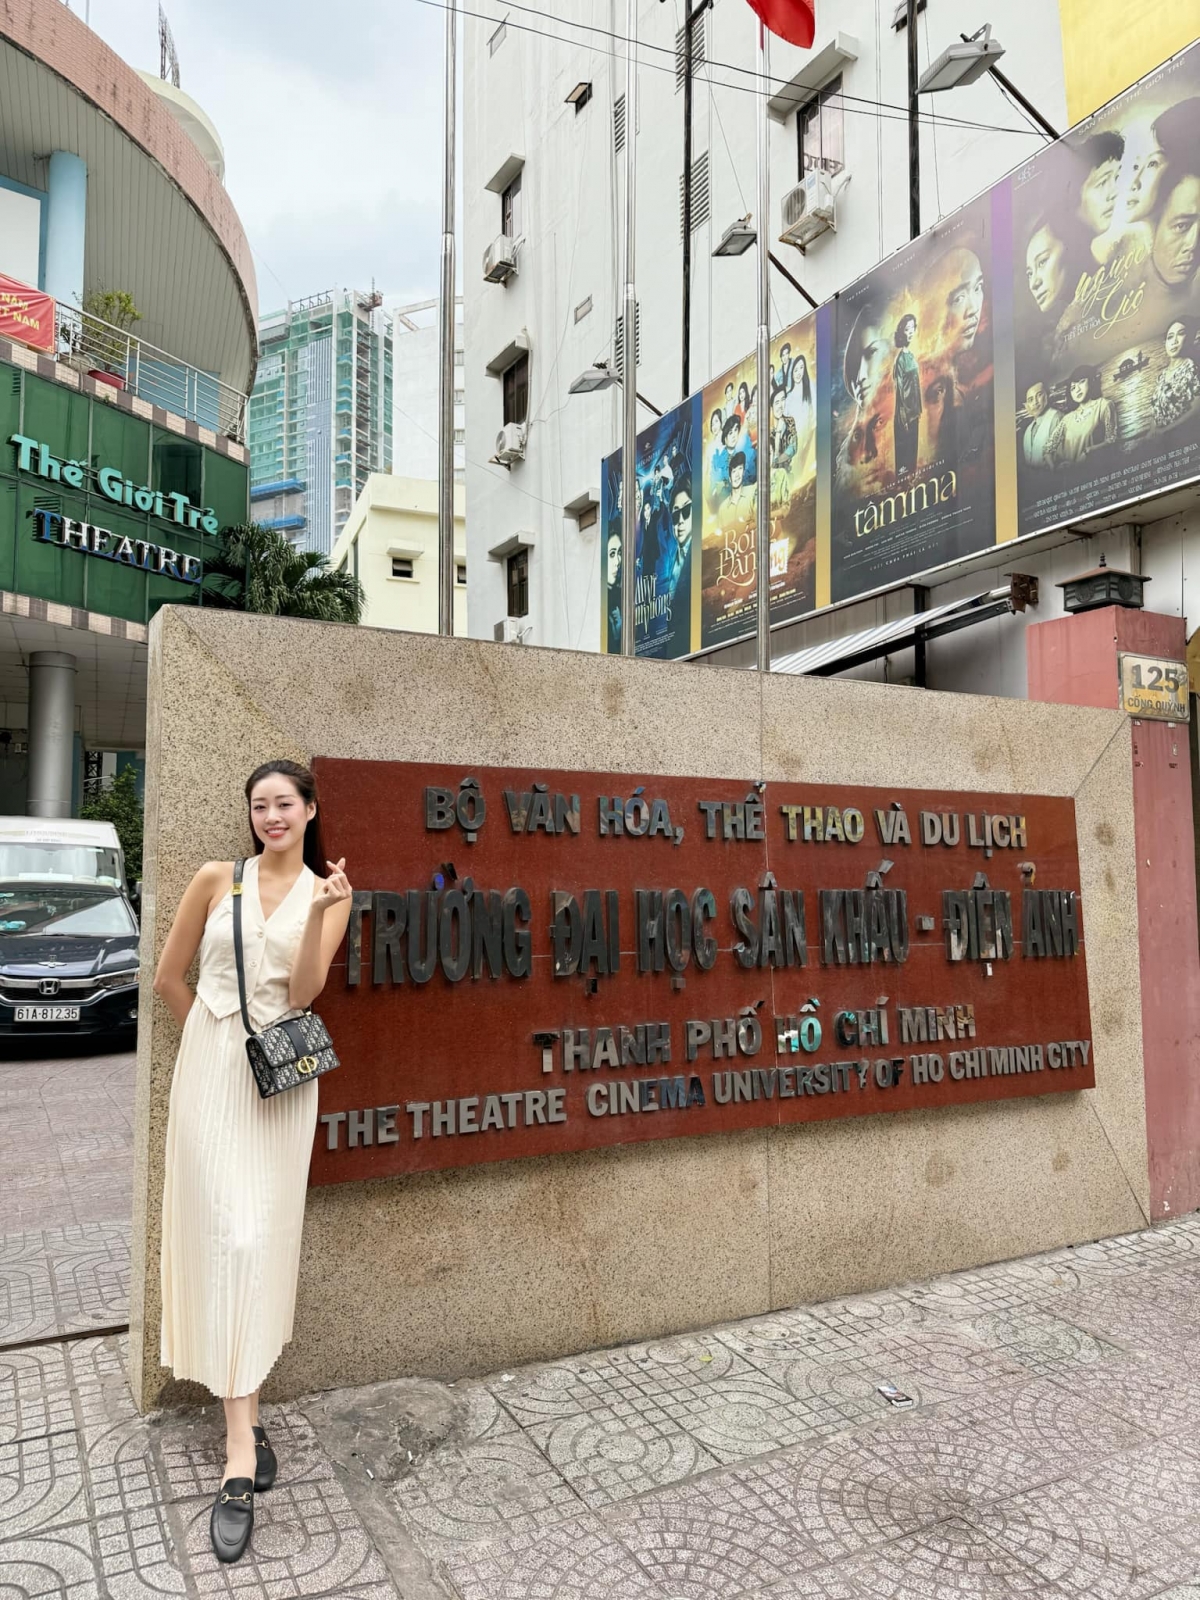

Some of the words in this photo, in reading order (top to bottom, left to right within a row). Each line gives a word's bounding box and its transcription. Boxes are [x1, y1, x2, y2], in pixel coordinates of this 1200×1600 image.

[12, 310, 40, 331] NAM
[10, 433, 88, 489] Thế
[97, 466, 163, 517] Giới
[168, 490, 219, 536] Trẻ
[32, 508, 202, 584] THEATRE
[1131, 664, 1180, 693] 125
[425, 778, 486, 842] BỘ
[504, 783, 581, 834] VĂN
[598, 786, 684, 846] HÓA,
[698, 780, 766, 840] THỂ
[781, 804, 866, 844] THAO
[874, 802, 912, 845] VÀ
[920, 811, 960, 847] DU
[965, 810, 1028, 858] LỊCH
[347, 862, 533, 985] TRƯỜNG
[549, 888, 620, 995] ĐẠI
[634, 886, 718, 991] HỌC
[731, 871, 809, 969] SÂN
[818, 859, 909, 967] KHẤU
[943, 871, 1014, 977] ĐIỆN
[1018, 861, 1080, 957] ẢNH
[16, 1007, 78, 1021] 61A-812.35
[533, 1022, 671, 1074] THANH
[686, 999, 764, 1060] PHỐ
[776, 996, 822, 1054] HỒ
[834, 995, 890, 1047] CHÍ
[899, 1003, 977, 1043] MINH
[320, 1104, 401, 1151] THE
[406, 1087, 568, 1139] THEATRE
[586, 1075, 706, 1118] CINEMA
[712, 1058, 870, 1105] UNIVERSITY
[875, 1058, 906, 1089] OF
[910, 1053, 945, 1085] HO
[949, 1048, 988, 1081] CHI
[990, 1045, 1045, 1077] MINH
[1047, 1040, 1092, 1070] CITY
